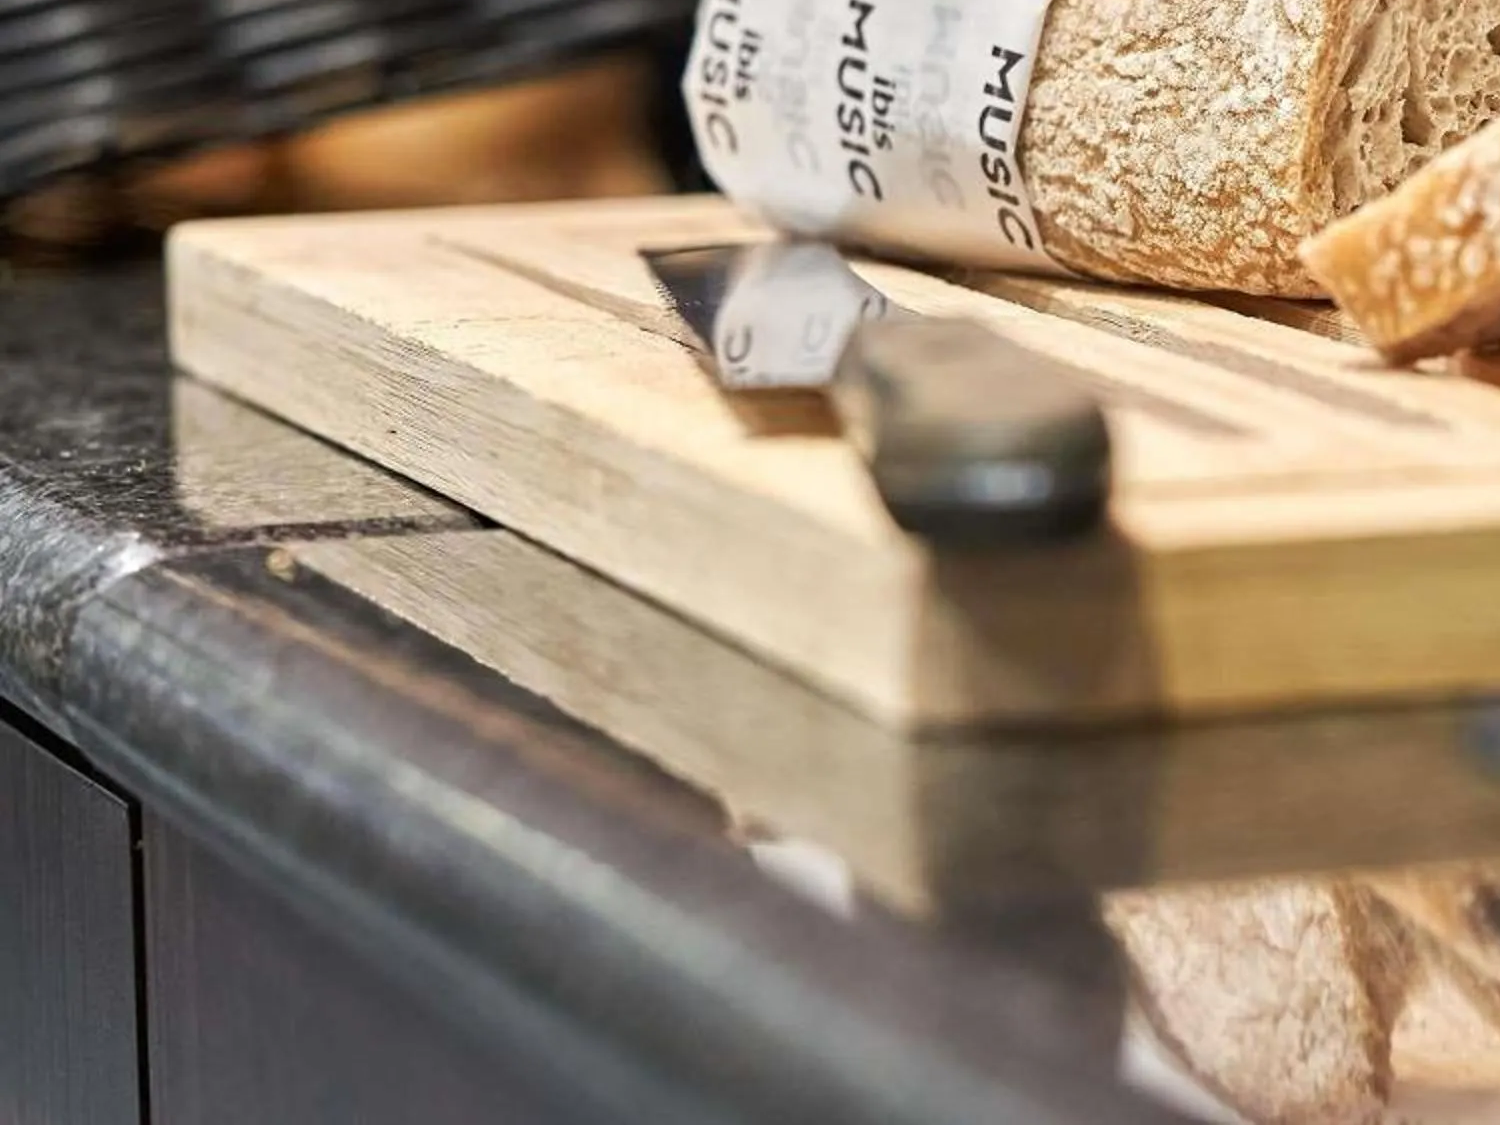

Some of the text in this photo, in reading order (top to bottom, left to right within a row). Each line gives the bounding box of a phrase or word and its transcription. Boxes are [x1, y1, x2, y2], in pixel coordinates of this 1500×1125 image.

[734, 29, 763, 101] ibis
[871, 76, 896, 152] ibis
[978, 45, 1034, 251] MUSIC
